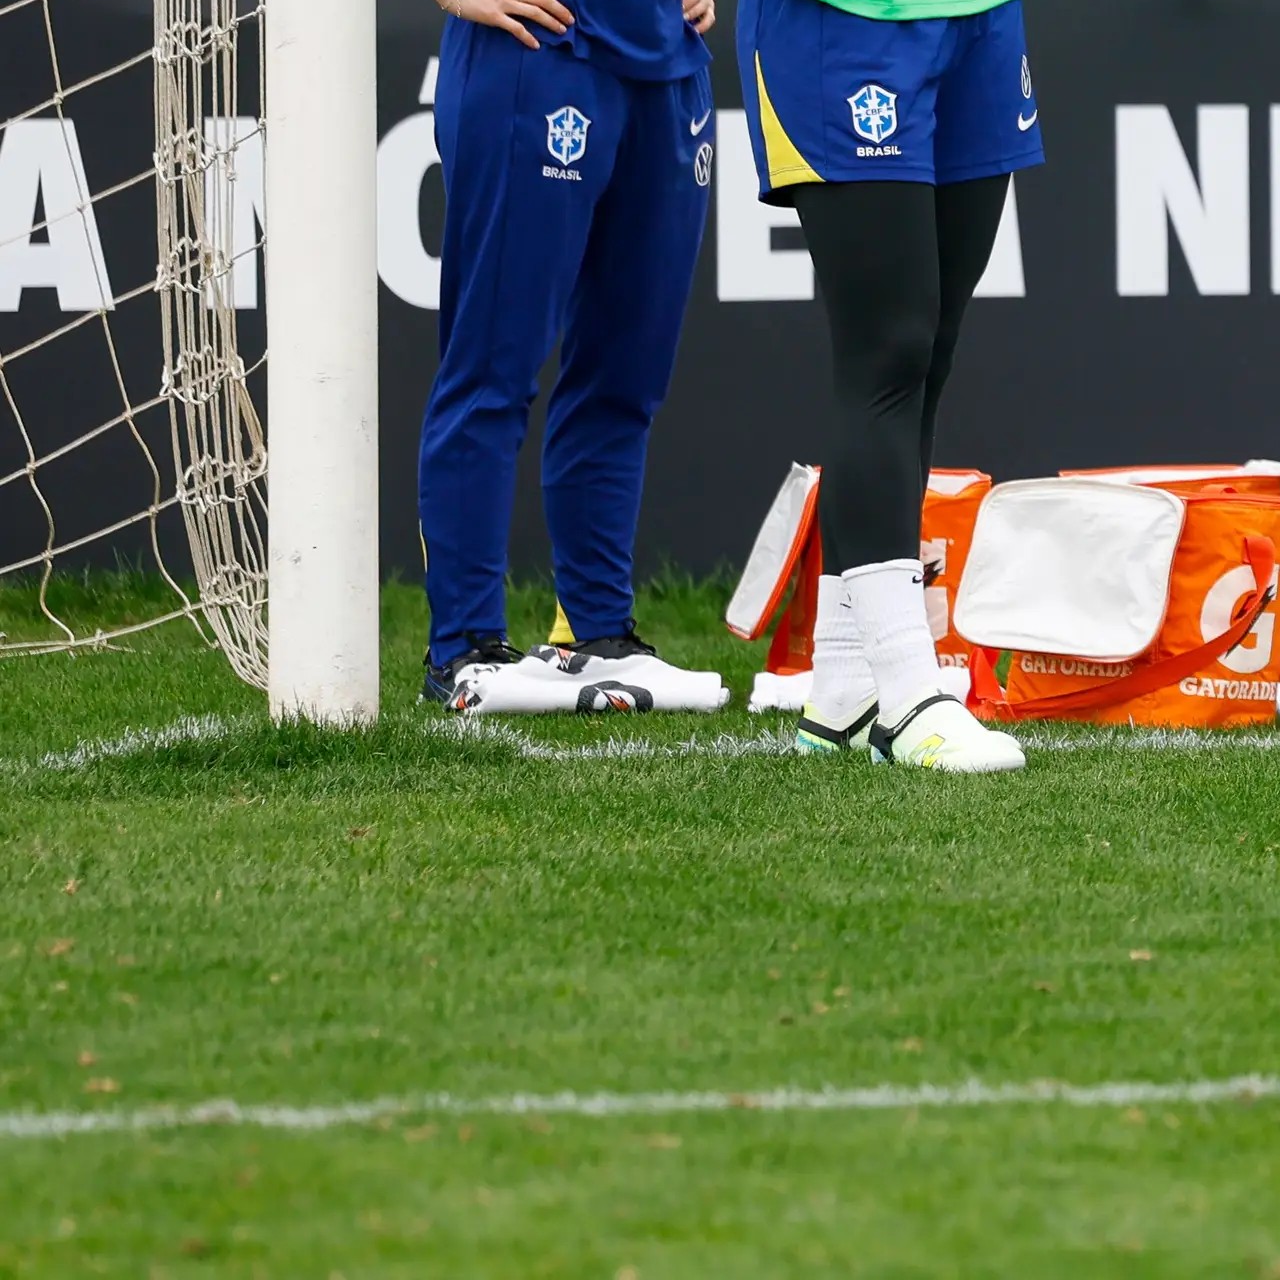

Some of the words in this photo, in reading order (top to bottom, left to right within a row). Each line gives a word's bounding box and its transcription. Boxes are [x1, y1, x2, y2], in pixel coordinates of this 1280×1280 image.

[856, 145, 902, 158] BRASIL
[542, 165, 582, 181] BRASIL
[1178, 677, 1277, 702] GATORADE
